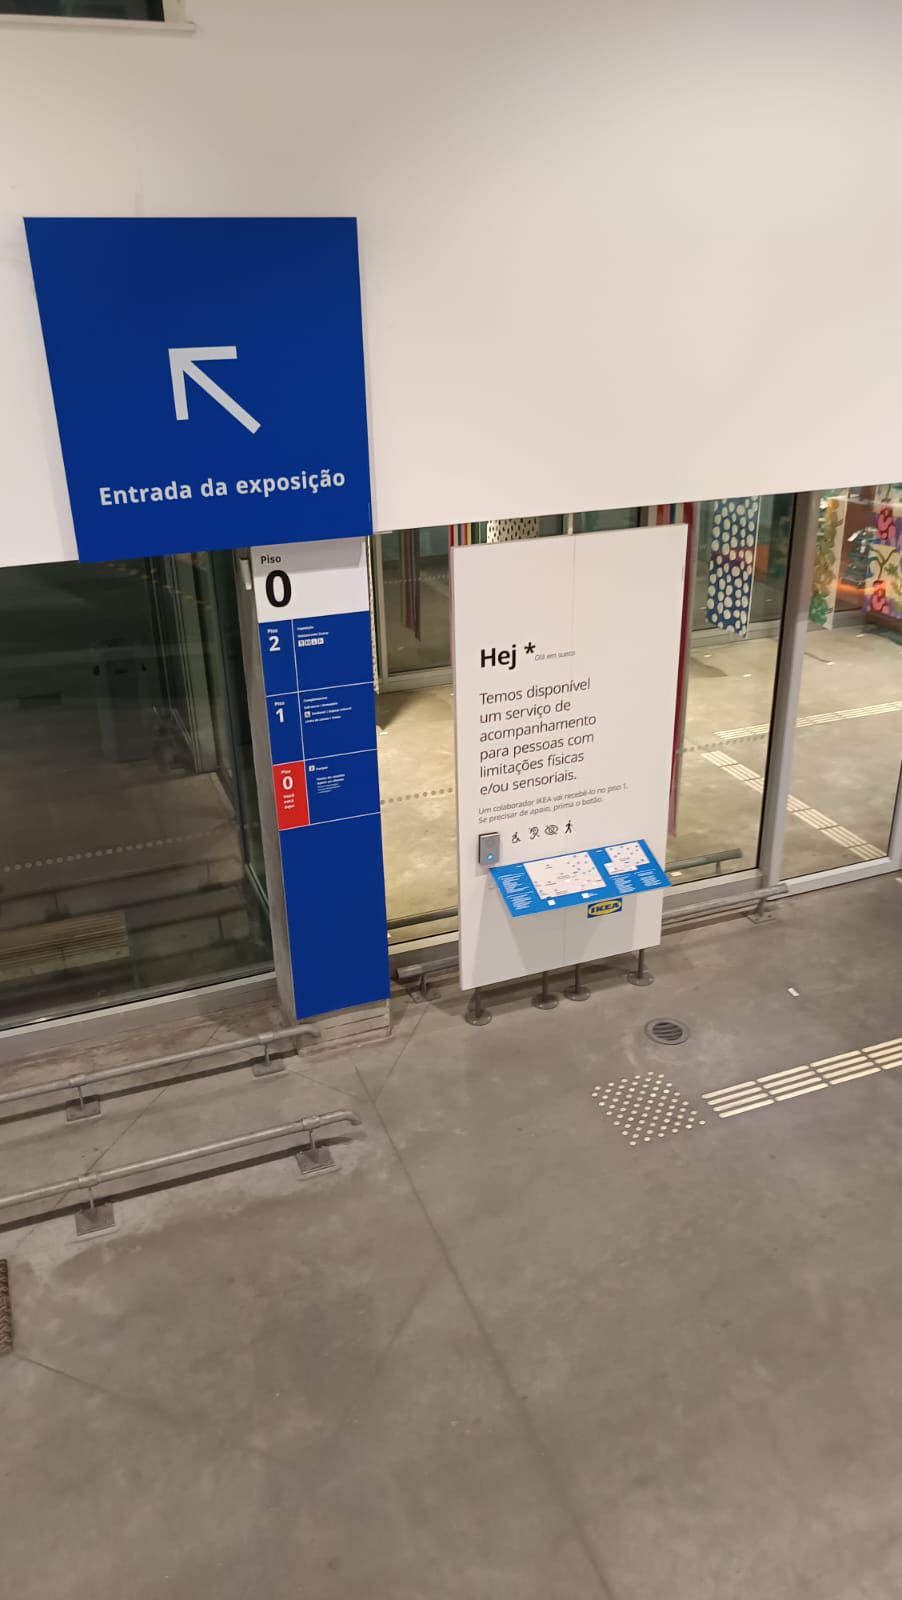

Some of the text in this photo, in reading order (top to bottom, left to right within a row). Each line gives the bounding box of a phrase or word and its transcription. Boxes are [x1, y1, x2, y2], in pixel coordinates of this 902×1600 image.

[98, 467, 346, 507] Entrada da exposição
[261, 555, 281, 564] Piso
[266, 570, 291, 608] 0
[269, 636, 280, 652] 2
[480, 644, 517, 670] Hej
[480, 678, 591, 705] Temos disponível
[275, 708, 284, 723] 1
[480, 700, 571, 724] um serviço de
[480, 715, 597, 742] acompanhamento
[480, 732, 594, 762] para pessoas com
[480, 751, 584, 778] limitações físicas
[282, 776, 293, 790] 0
[480, 770, 577, 795] e/ou sensoriais.
[478, 807, 491, 815] Um
[493, 799, 534, 813] colaborador
[536, 796, 552, 805] IKEA
[478, 816, 487, 824] Se
[489, 810, 517, 823] precisar
[519, 809, 528, 817] de
[554, 802, 574, 813] prima
[590, 902, 620, 914] IKEA
